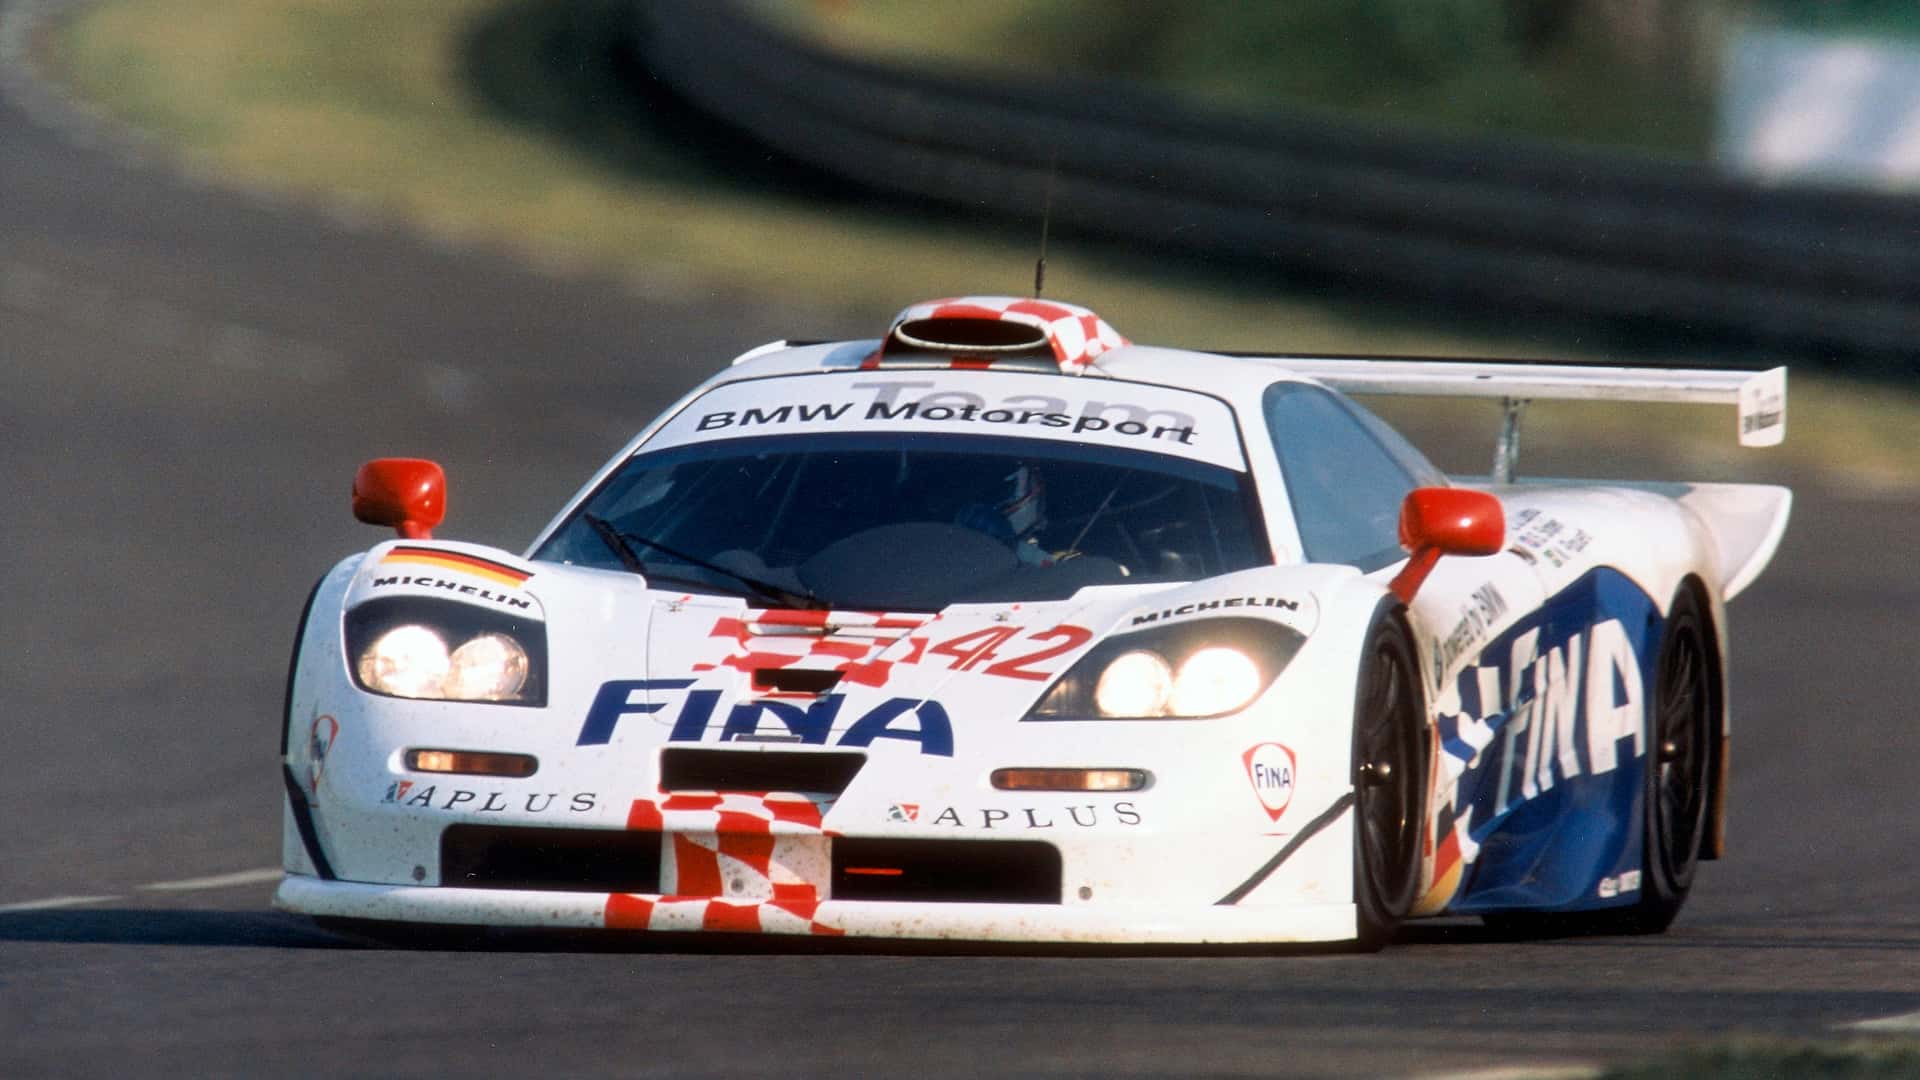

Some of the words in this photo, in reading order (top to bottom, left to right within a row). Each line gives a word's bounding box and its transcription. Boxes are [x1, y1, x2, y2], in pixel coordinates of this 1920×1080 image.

[695, 402, 854, 432] BMW
[864, 402, 1199, 446] Motorsport
[851, 381, 1197, 443] Team
[372, 575, 530, 609] MICHELIN
[1131, 598, 1299, 626] MICHELIN
[928, 624, 1094, 681] 42
[575, 678, 954, 757] FINA
[1495, 618, 1645, 816] FINA
[1255, 763, 1291, 788] FINA
[407, 785, 597, 812] APLUS
[933, 802, 1142, 828] APLUS
